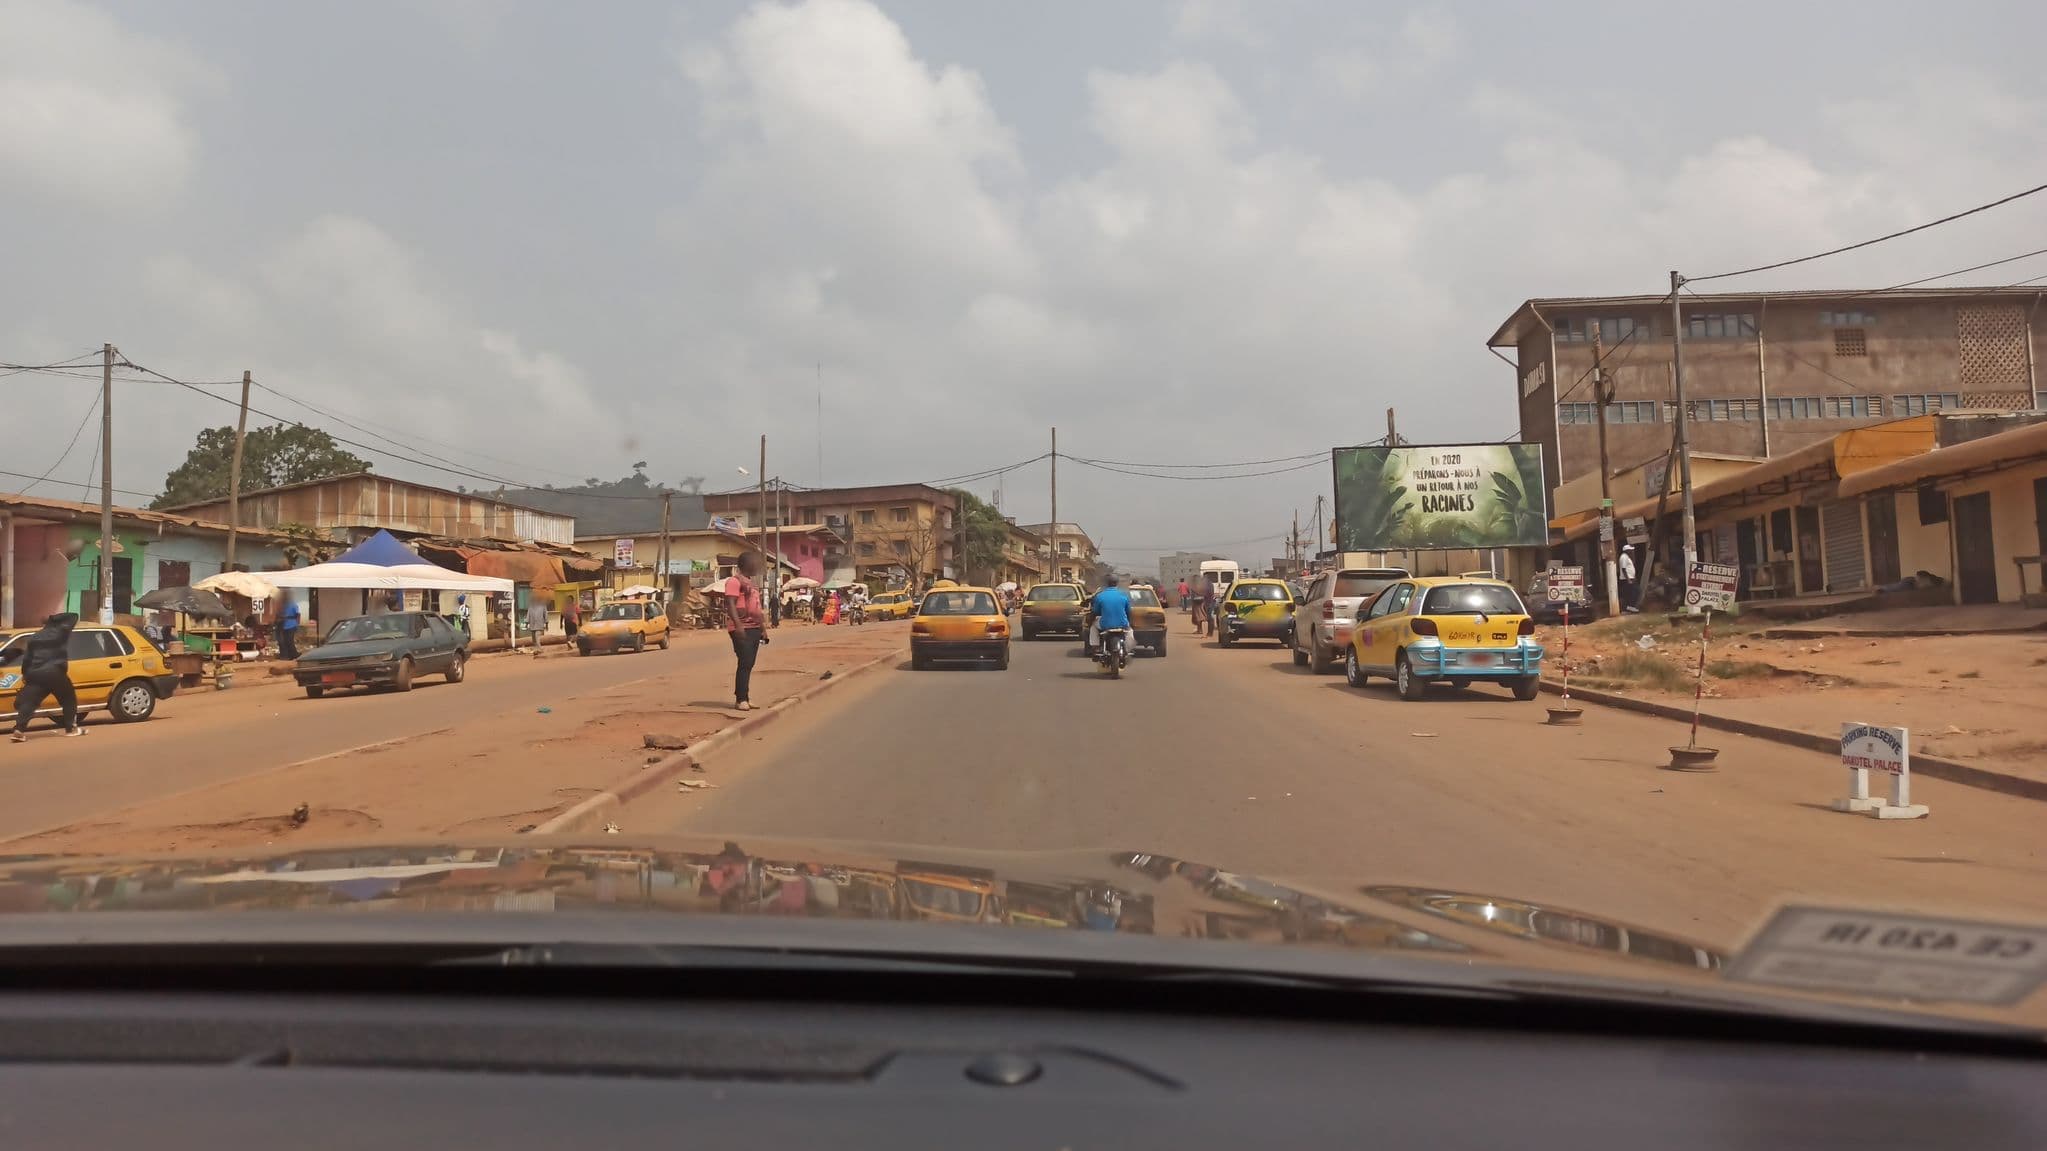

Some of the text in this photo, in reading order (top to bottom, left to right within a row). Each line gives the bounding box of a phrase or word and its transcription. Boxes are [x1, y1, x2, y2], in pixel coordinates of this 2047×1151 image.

[1442, 454, 1461, 465] 2020
[1416, 479, 1478, 492] UN RETOUR À NOS
[1422, 494, 1475, 513] RACINES
[1703, 564, 1737, 577] RESERVE
[253, 600, 264, 611] 50
[1841, 726, 1903, 756] PARKING RESERVE
[1874, 759, 1903, 773] PALACE
